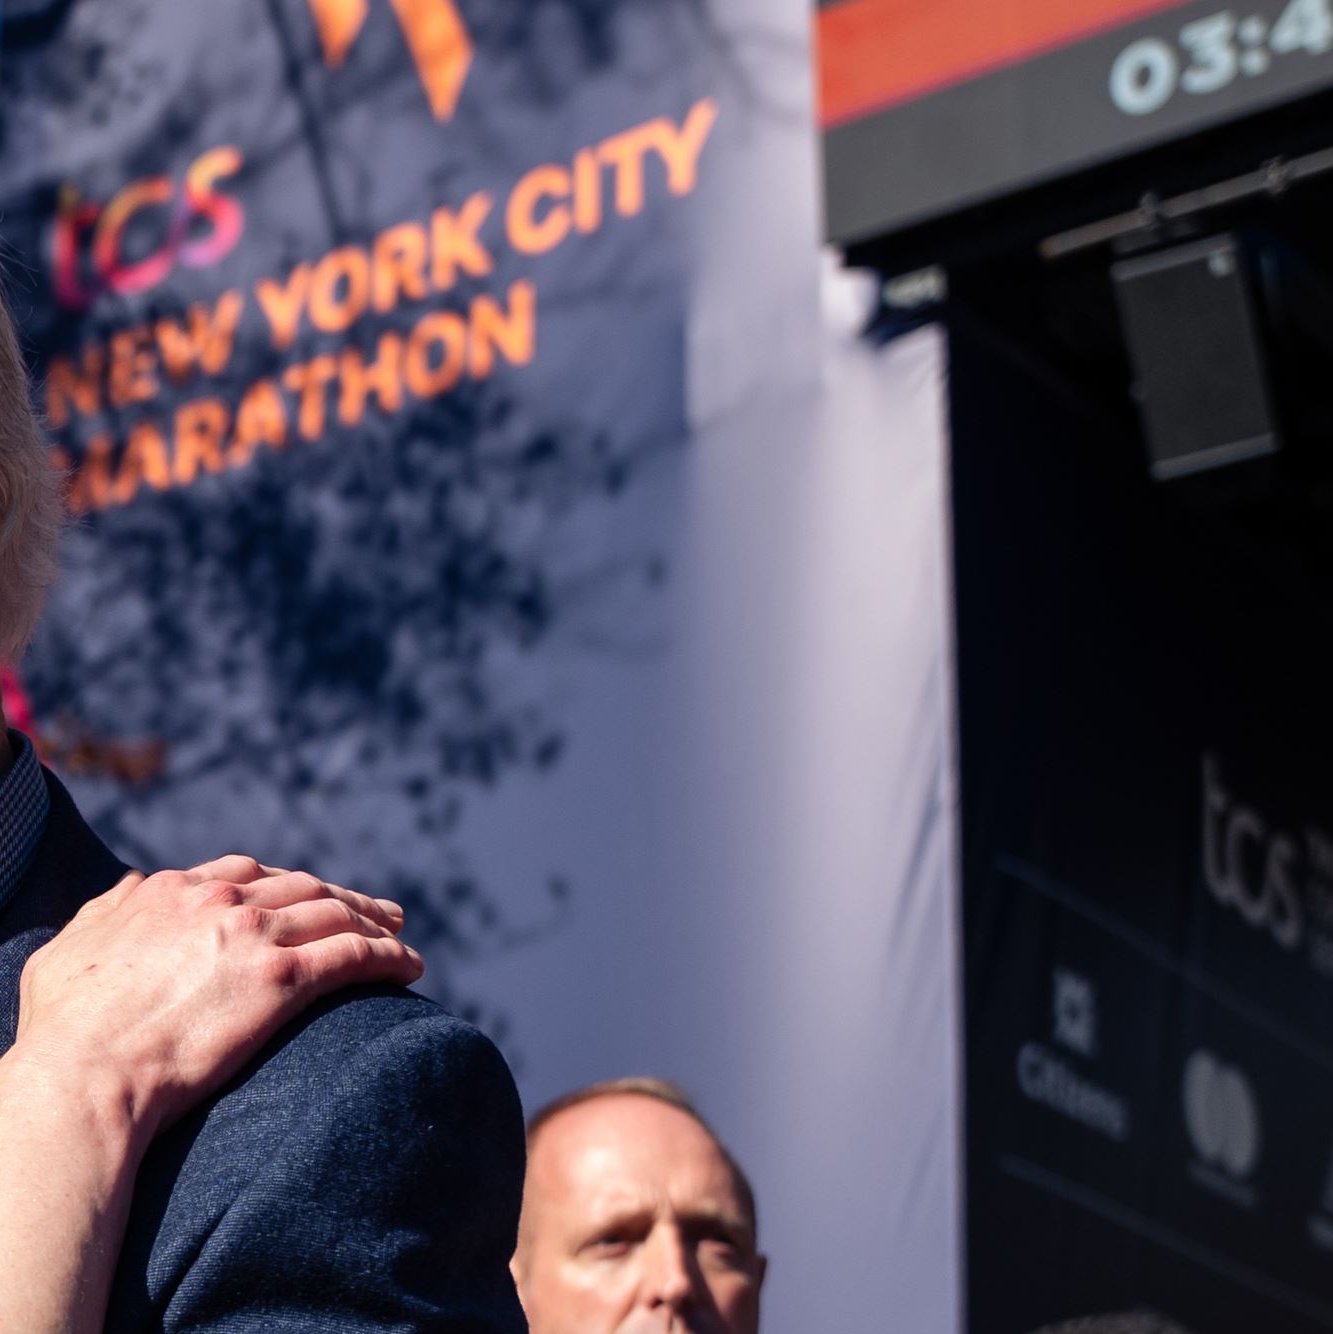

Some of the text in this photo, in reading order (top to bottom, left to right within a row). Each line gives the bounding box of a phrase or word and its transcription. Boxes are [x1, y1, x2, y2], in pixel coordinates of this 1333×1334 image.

[45, 98, 717, 430] NEW YORK CITY
